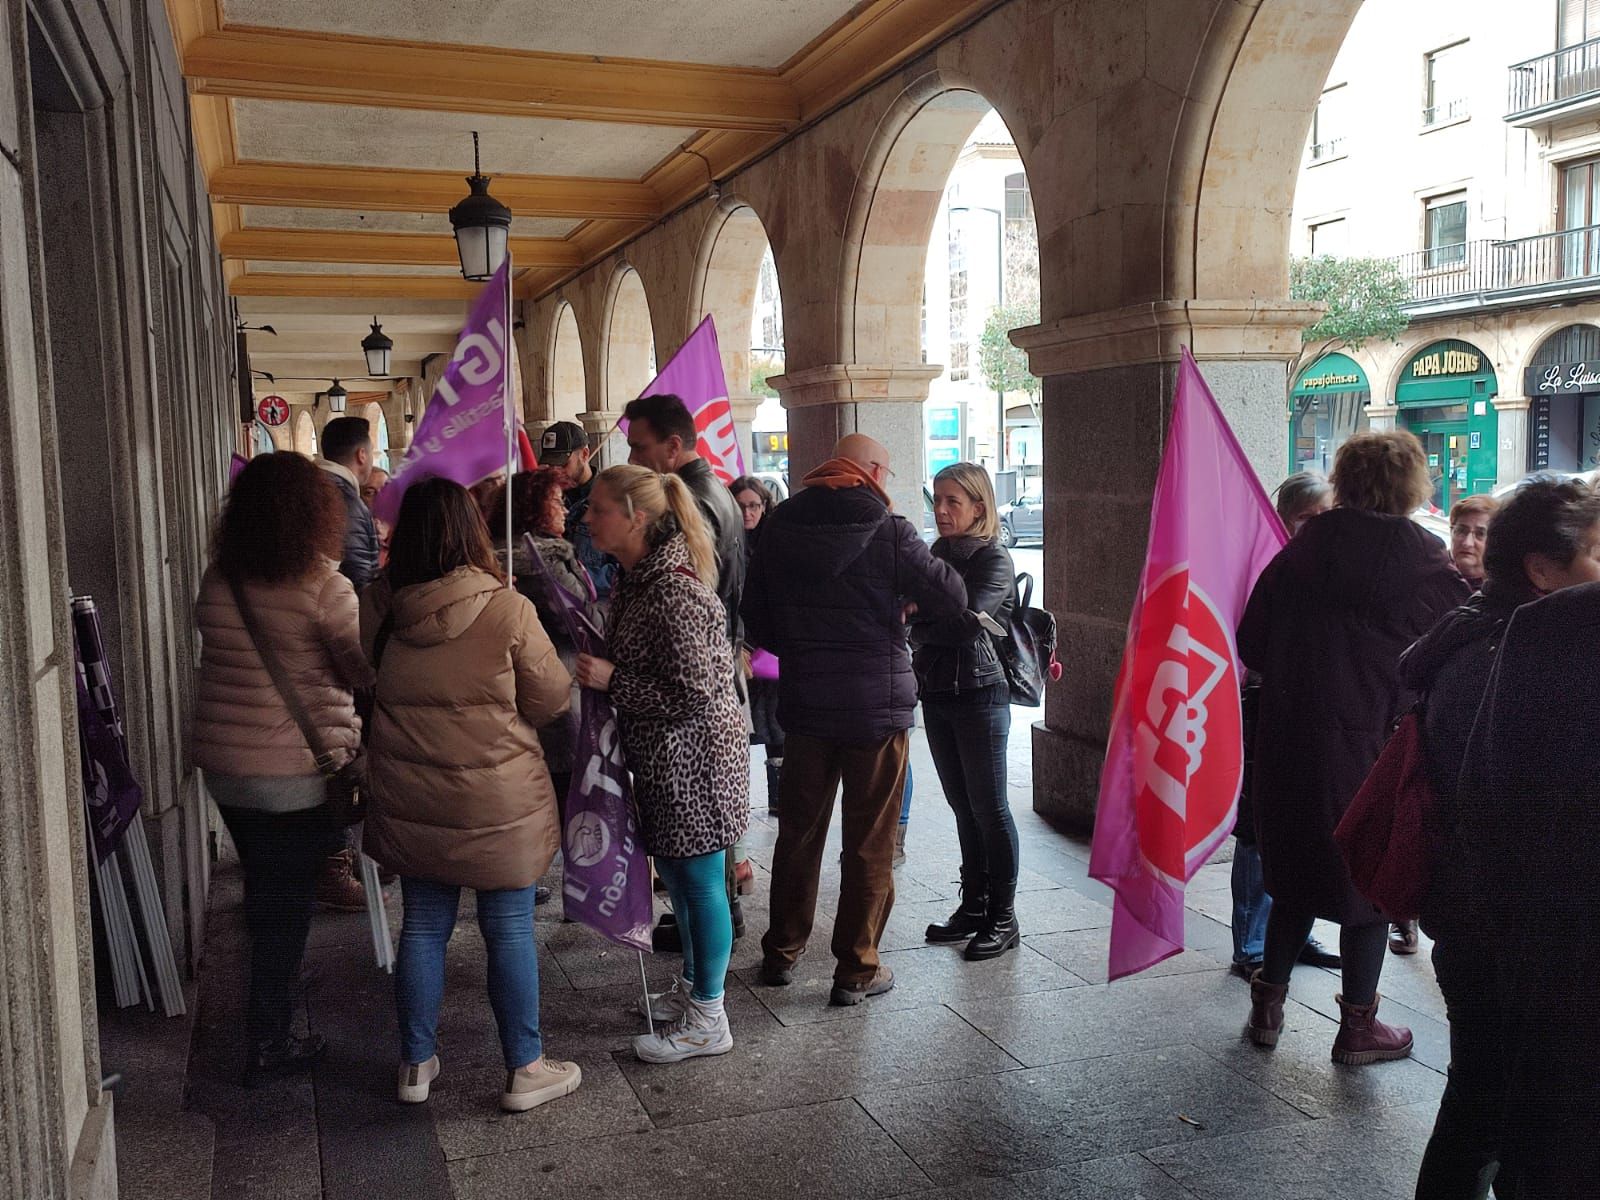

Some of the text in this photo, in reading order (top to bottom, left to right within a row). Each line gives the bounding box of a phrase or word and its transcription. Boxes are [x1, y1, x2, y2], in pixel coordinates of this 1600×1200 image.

[1412, 350, 1479, 377] PAPA JOHNS
[1303, 372, 1358, 389] papajohns.es
[1539, 365, 1562, 394] La
